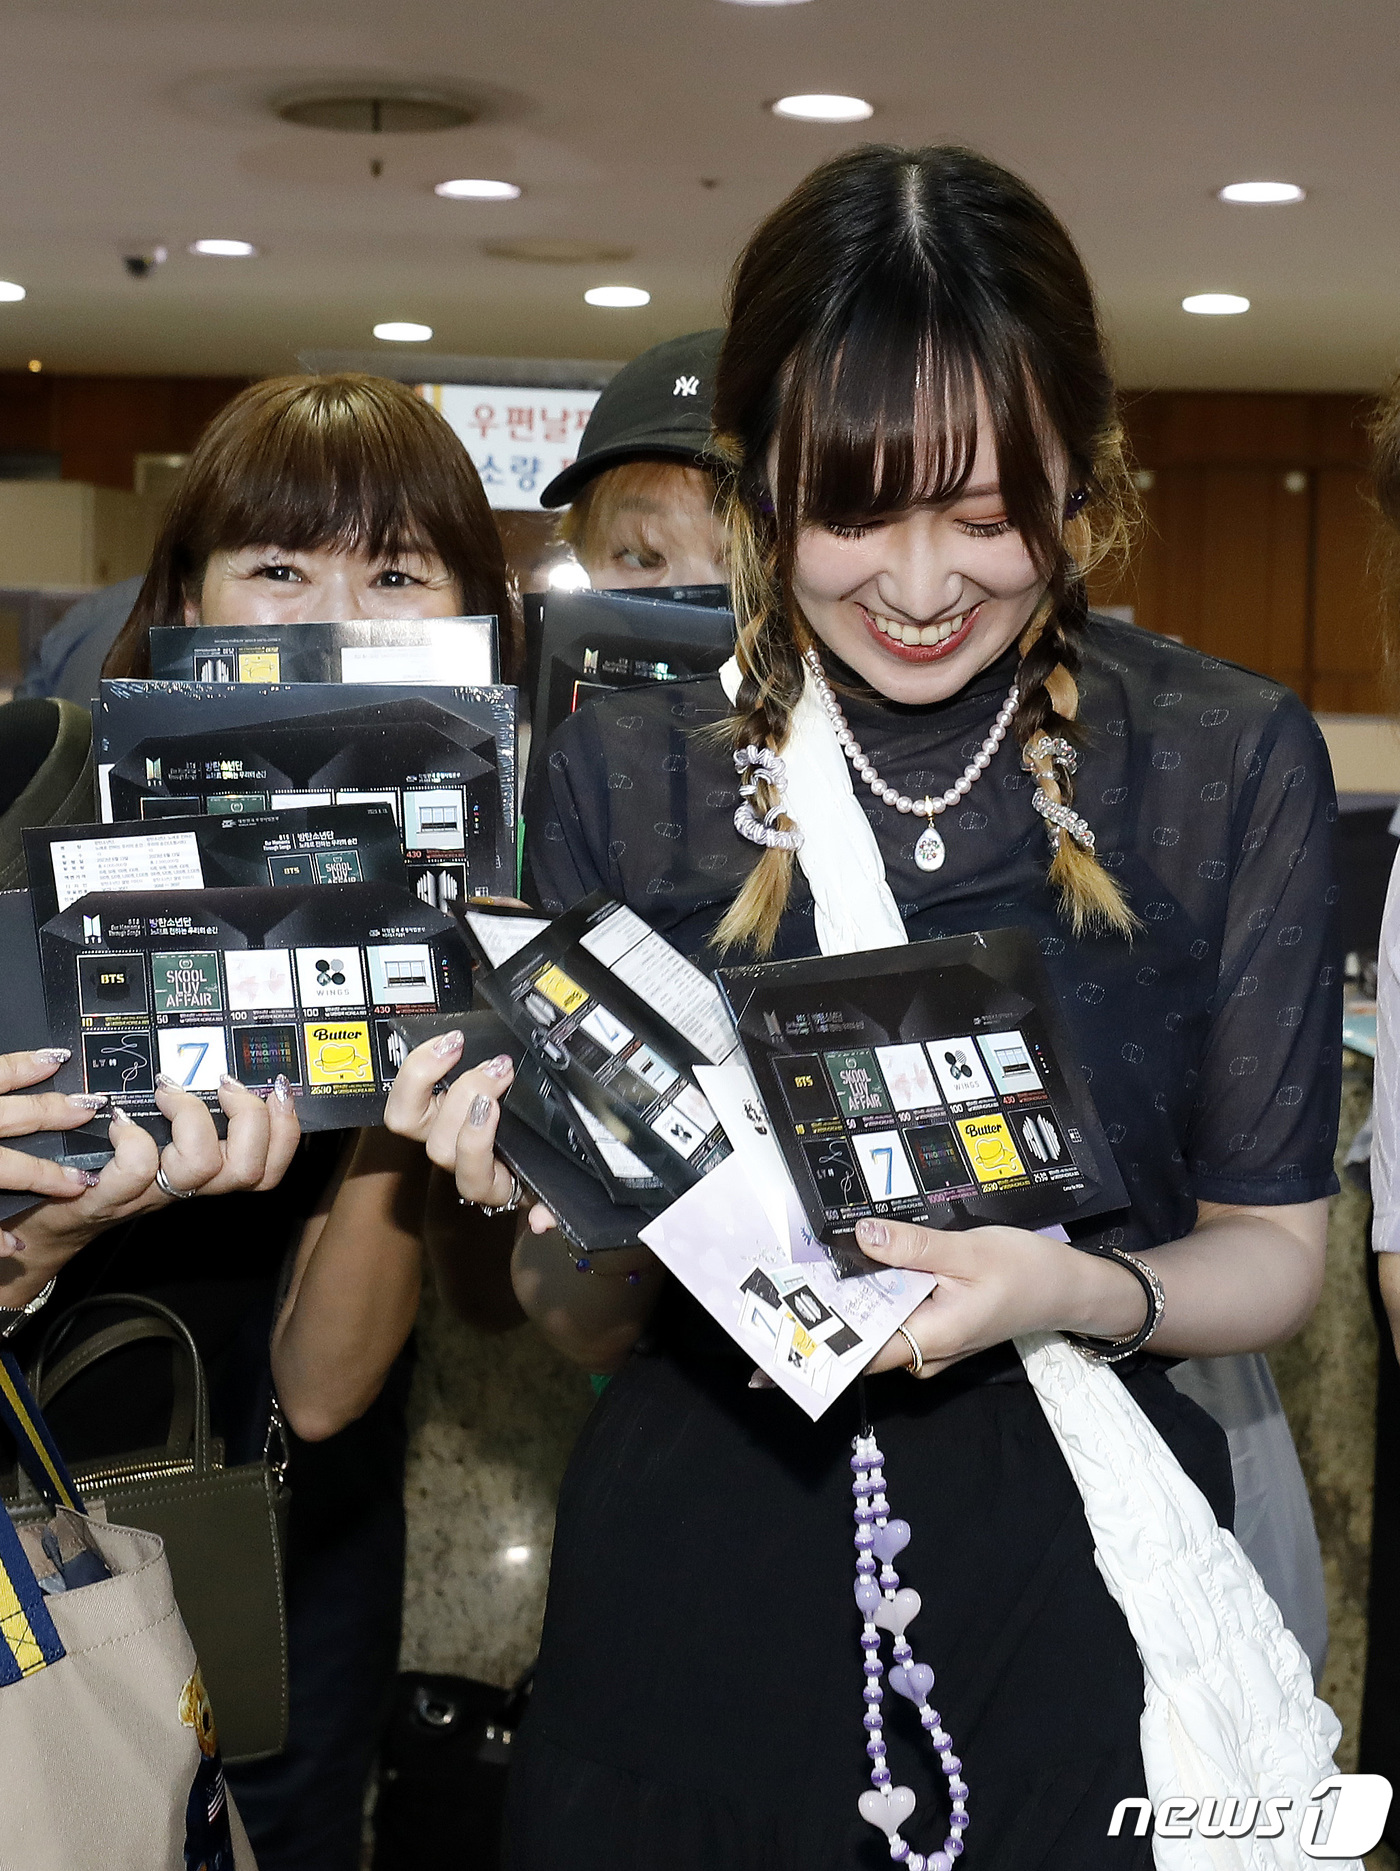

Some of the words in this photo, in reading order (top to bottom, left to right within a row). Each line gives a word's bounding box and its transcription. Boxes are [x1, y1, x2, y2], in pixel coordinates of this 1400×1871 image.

[406, 851, 422, 859] 430
[325, 861, 353, 872] SKOOL
[149, 916, 192, 928] 방탄소년단
[100, 973, 125, 984] BTS
[166, 969, 207, 985] SKOOL
[175, 981, 200, 995] LUV
[166, 993, 213, 1008] AFFAIR
[302, 1008, 319, 1018] 100
[374, 1005, 391, 1014] 430
[156, 1014, 169, 1025] 50
[230, 1011, 248, 1021] 100
[81, 1017, 94, 1028] 10
[313, 1028, 363, 1042] Butter
[177, 1042, 210, 1087] 7
[794, 1074, 814, 1088] BTS
[839, 1067, 872, 1085] SKOOL
[848, 1080, 870, 1097] LUV
[953, 1080, 980, 1092] WINGS
[848, 1092, 883, 1112] AFFAIR
[1002, 1095, 1016, 1105] 430
[949, 1103, 964, 1114] 100
[897, 1111, 912, 1123] 100
[965, 1123, 1003, 1138] Butter
[869, 1146, 893, 1196] 7
